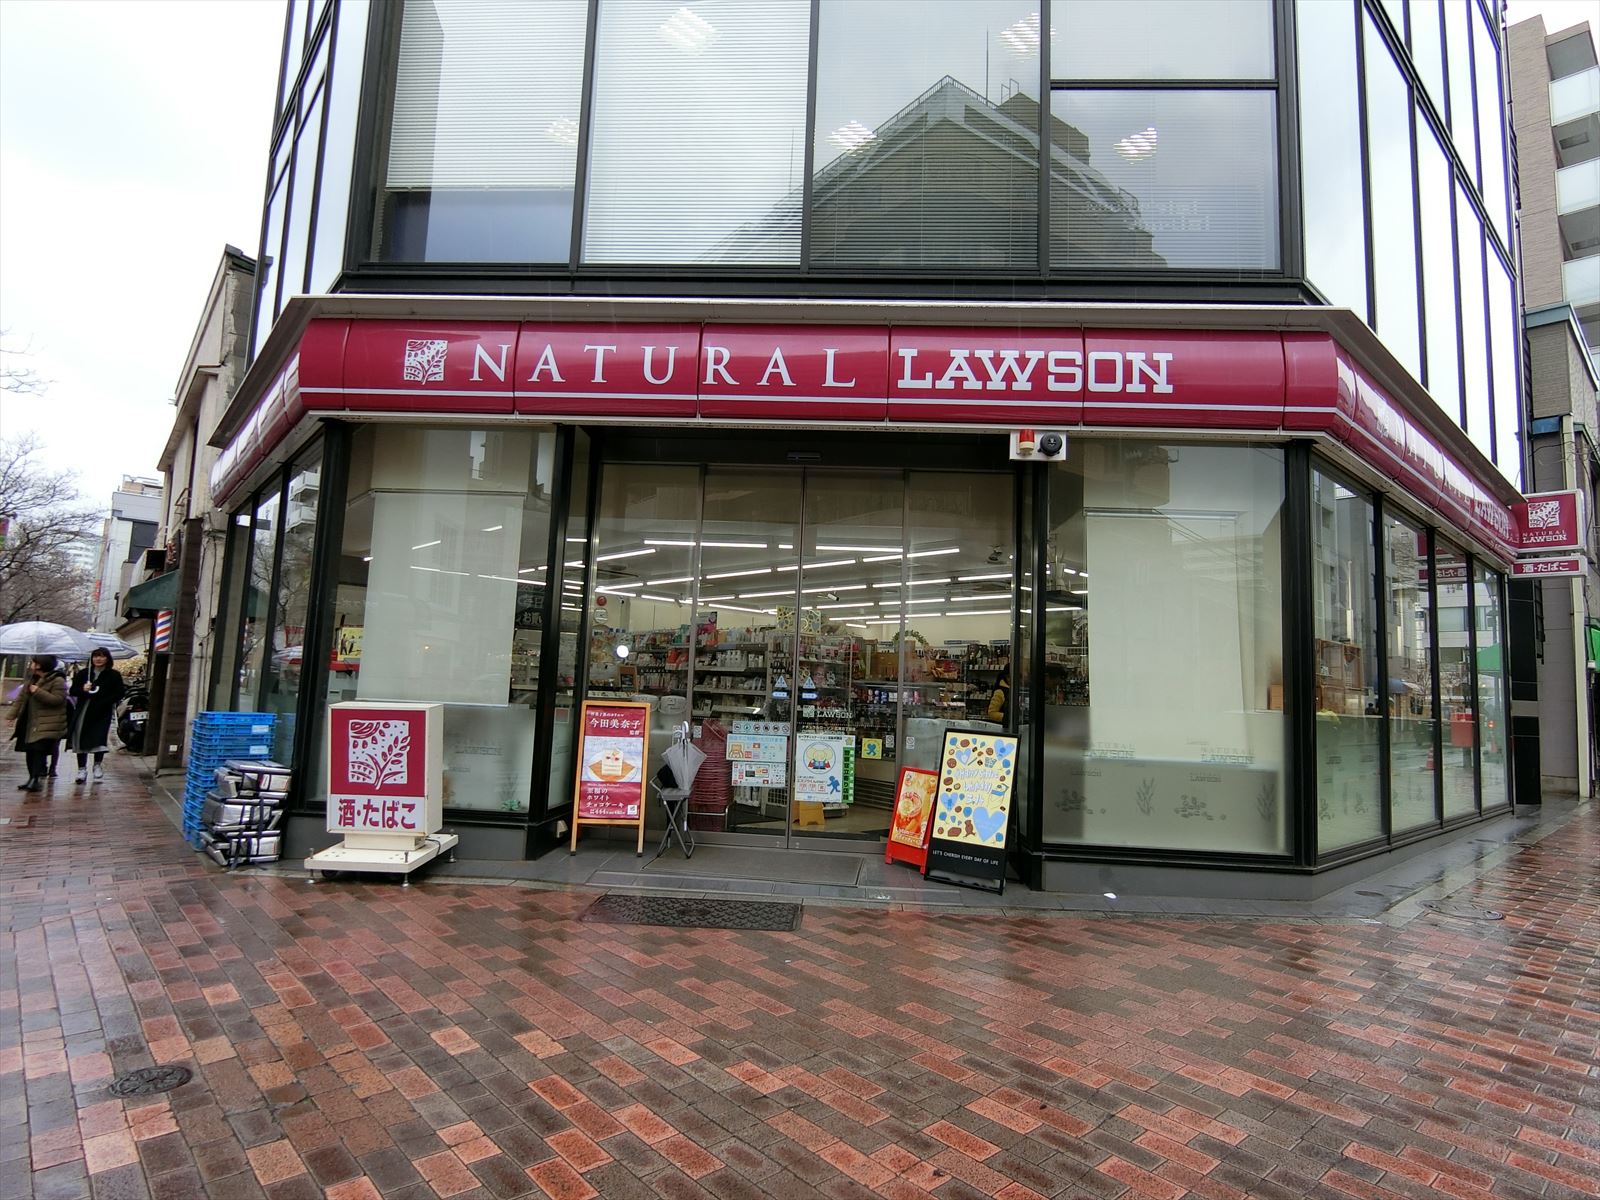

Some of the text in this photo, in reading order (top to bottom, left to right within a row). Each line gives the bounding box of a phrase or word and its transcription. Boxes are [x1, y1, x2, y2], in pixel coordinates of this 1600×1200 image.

[470, 343, 1174, 394] NATURAL LAWSON
[1522, 535, 1568, 544] LAWSON
[817, 710, 854, 719] LAWSON
[590, 718, 641, 729] 今田美奈子
[338, 798, 416, 830] 酒・たばこ
[943, 851, 961, 859] CHERISH
